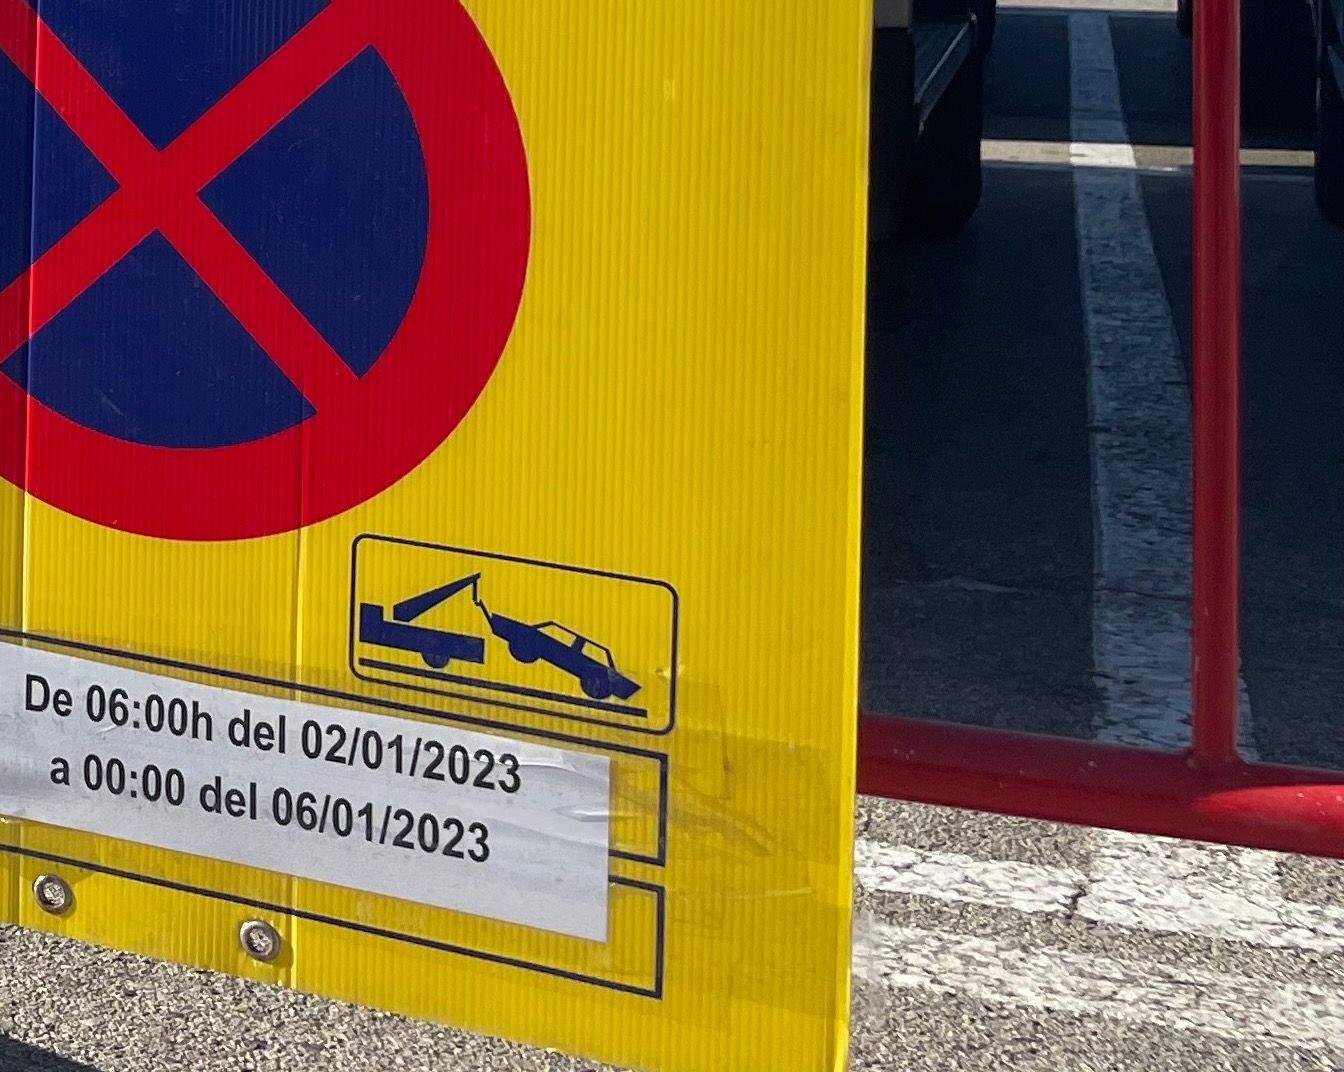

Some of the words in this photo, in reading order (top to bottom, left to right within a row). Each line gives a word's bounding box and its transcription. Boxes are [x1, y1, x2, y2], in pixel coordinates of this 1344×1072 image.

[24, 672, 74, 717] De
[85, 684, 213, 741] 06:00h
[227, 708, 287, 755] del
[300, 718, 523, 795] 02/01/2023
[49, 755, 71, 787] a
[83, 753, 186, 806] 00:00
[198, 774, 257, 821] del
[271, 786, 492, 863] 06/01/2023
